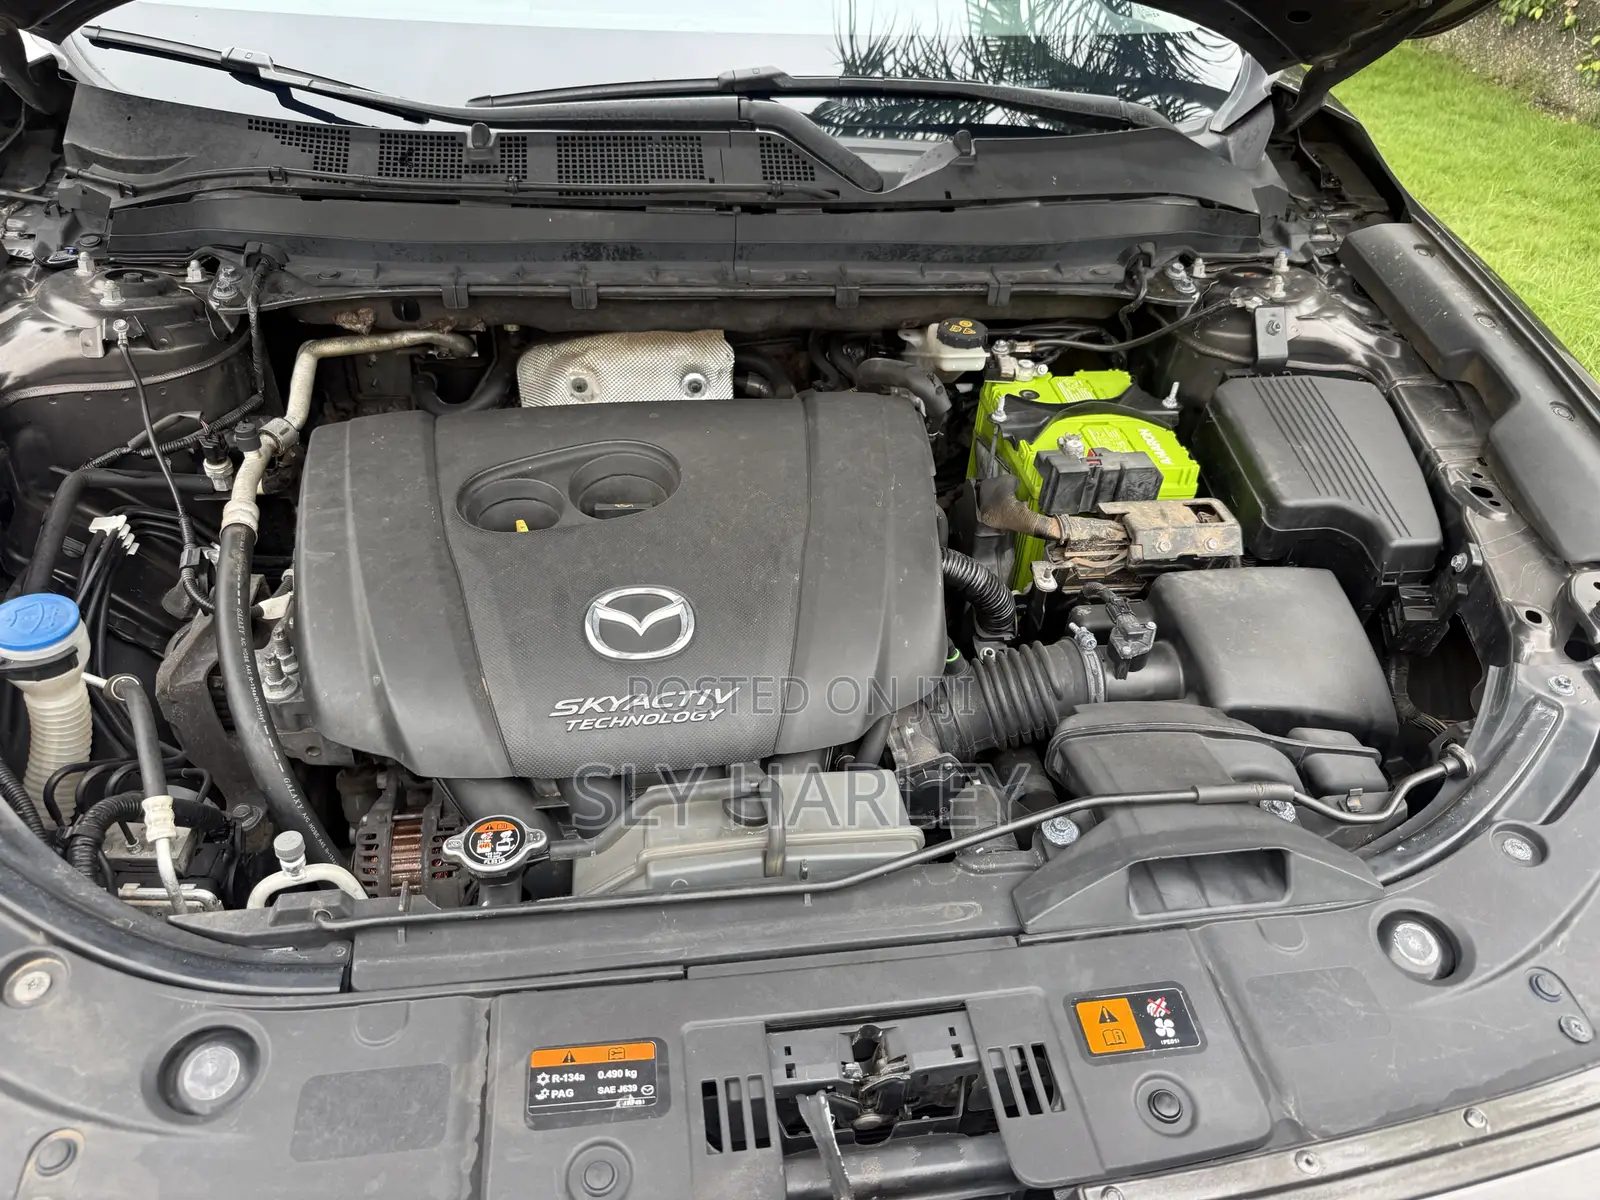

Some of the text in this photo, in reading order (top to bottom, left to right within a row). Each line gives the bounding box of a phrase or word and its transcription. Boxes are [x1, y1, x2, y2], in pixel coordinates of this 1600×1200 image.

[1137, 428, 1174, 465] AMARON
[236, 607, 246, 636] GALAXY
[548, 686, 741, 717] SKYACTIV
[566, 708, 726, 732] TECHNOLOGY
[283, 777, 305, 810] GALAXY
[308, 822, 320, 839] HOSE
[551, 1068, 638, 1084] R-134a 0.490 kg
[550, 1083, 638, 1099] PAG SAE J639
